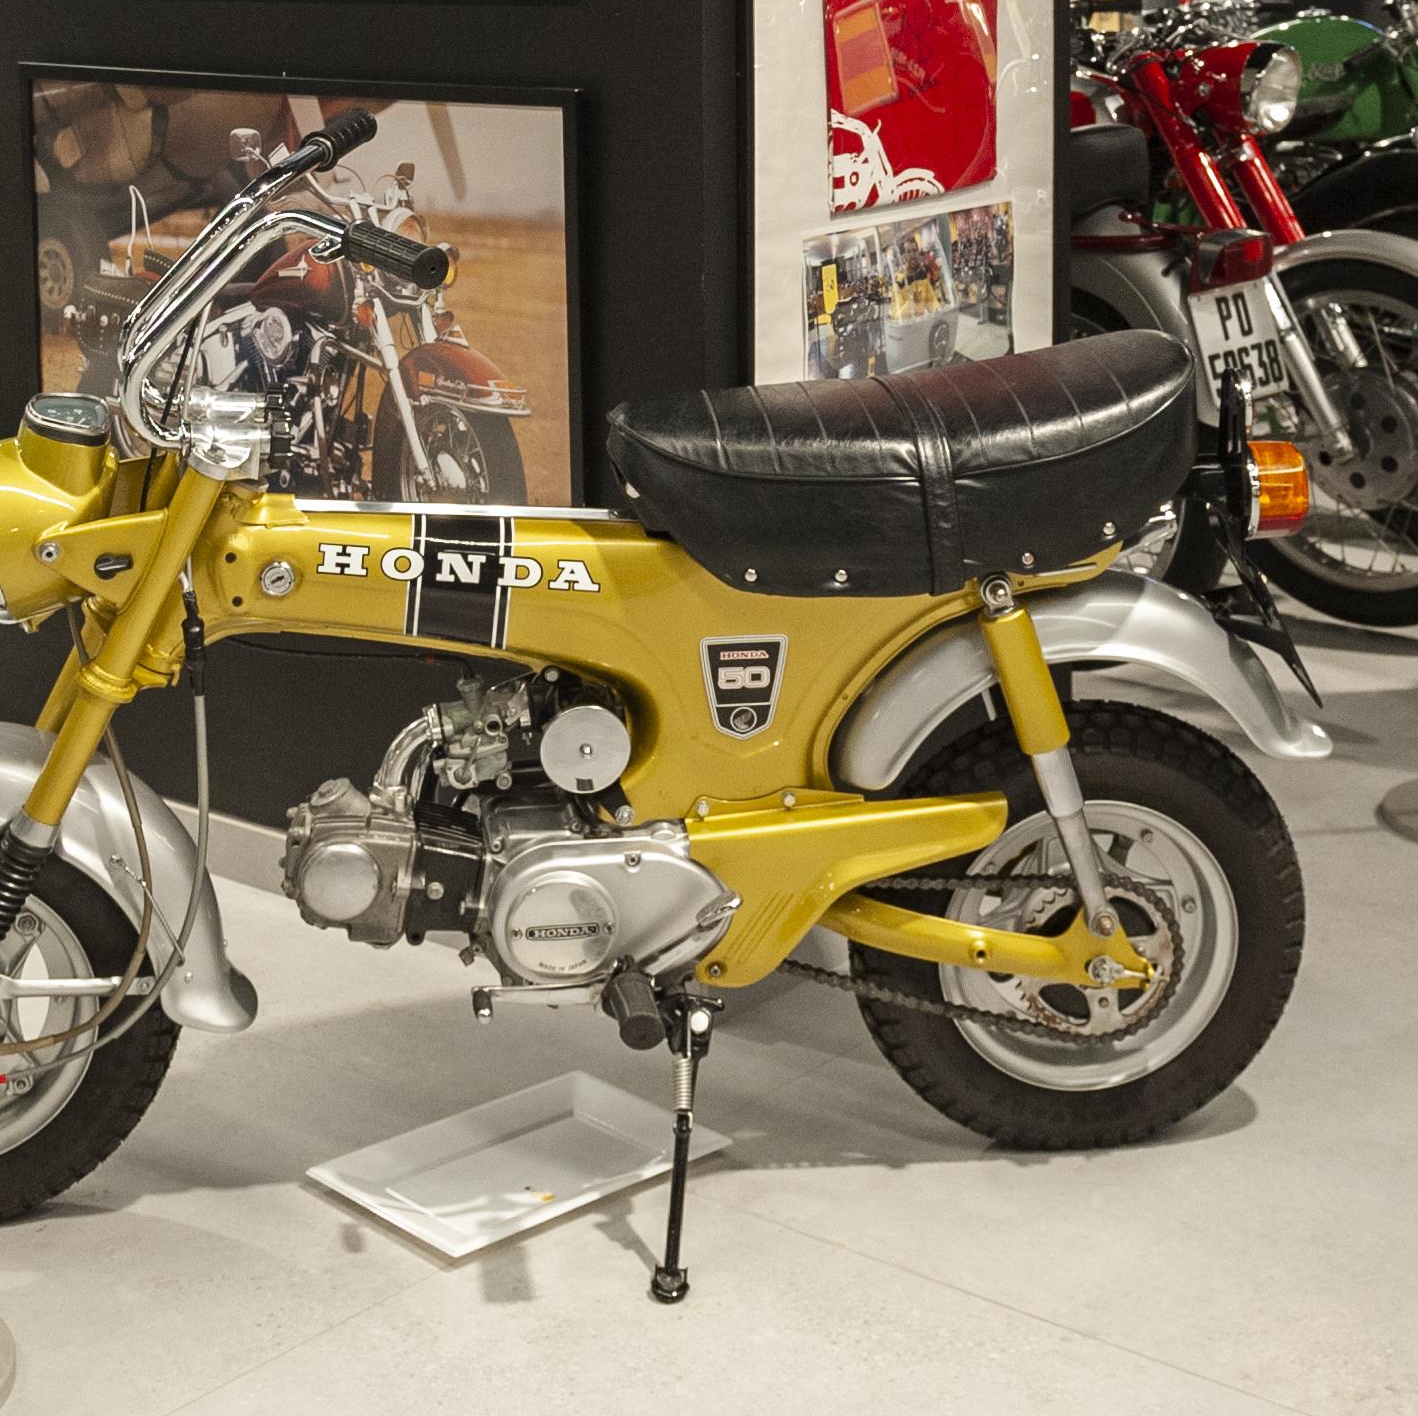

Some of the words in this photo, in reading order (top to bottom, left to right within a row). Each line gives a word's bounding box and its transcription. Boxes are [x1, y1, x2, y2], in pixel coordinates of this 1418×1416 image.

[316, 543, 601, 593] HONDA
[720, 650, 770, 660] HONDA
[718, 666, 771, 689] 50
[533, 926, 593, 938] HONDA
[539, 962, 556, 971] MADE
[568, 959, 587, 971] JAPAN
